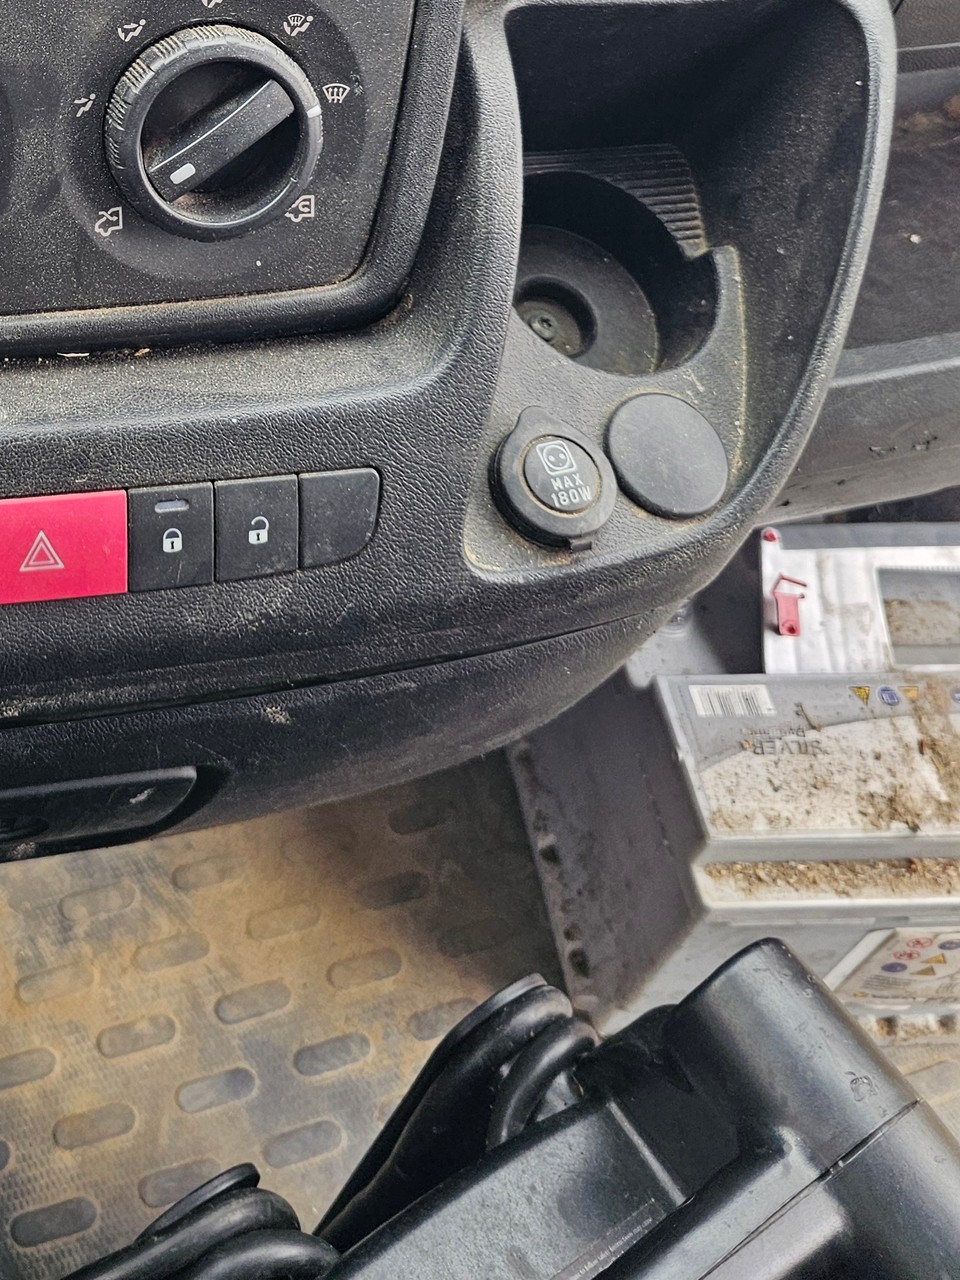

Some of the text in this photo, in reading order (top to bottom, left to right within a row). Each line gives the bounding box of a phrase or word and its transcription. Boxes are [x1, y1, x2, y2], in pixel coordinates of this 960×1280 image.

[550, 473, 584, 491] MAX
[551, 485, 592, 507] 180W
[752, 739, 823, 756] SILVER
